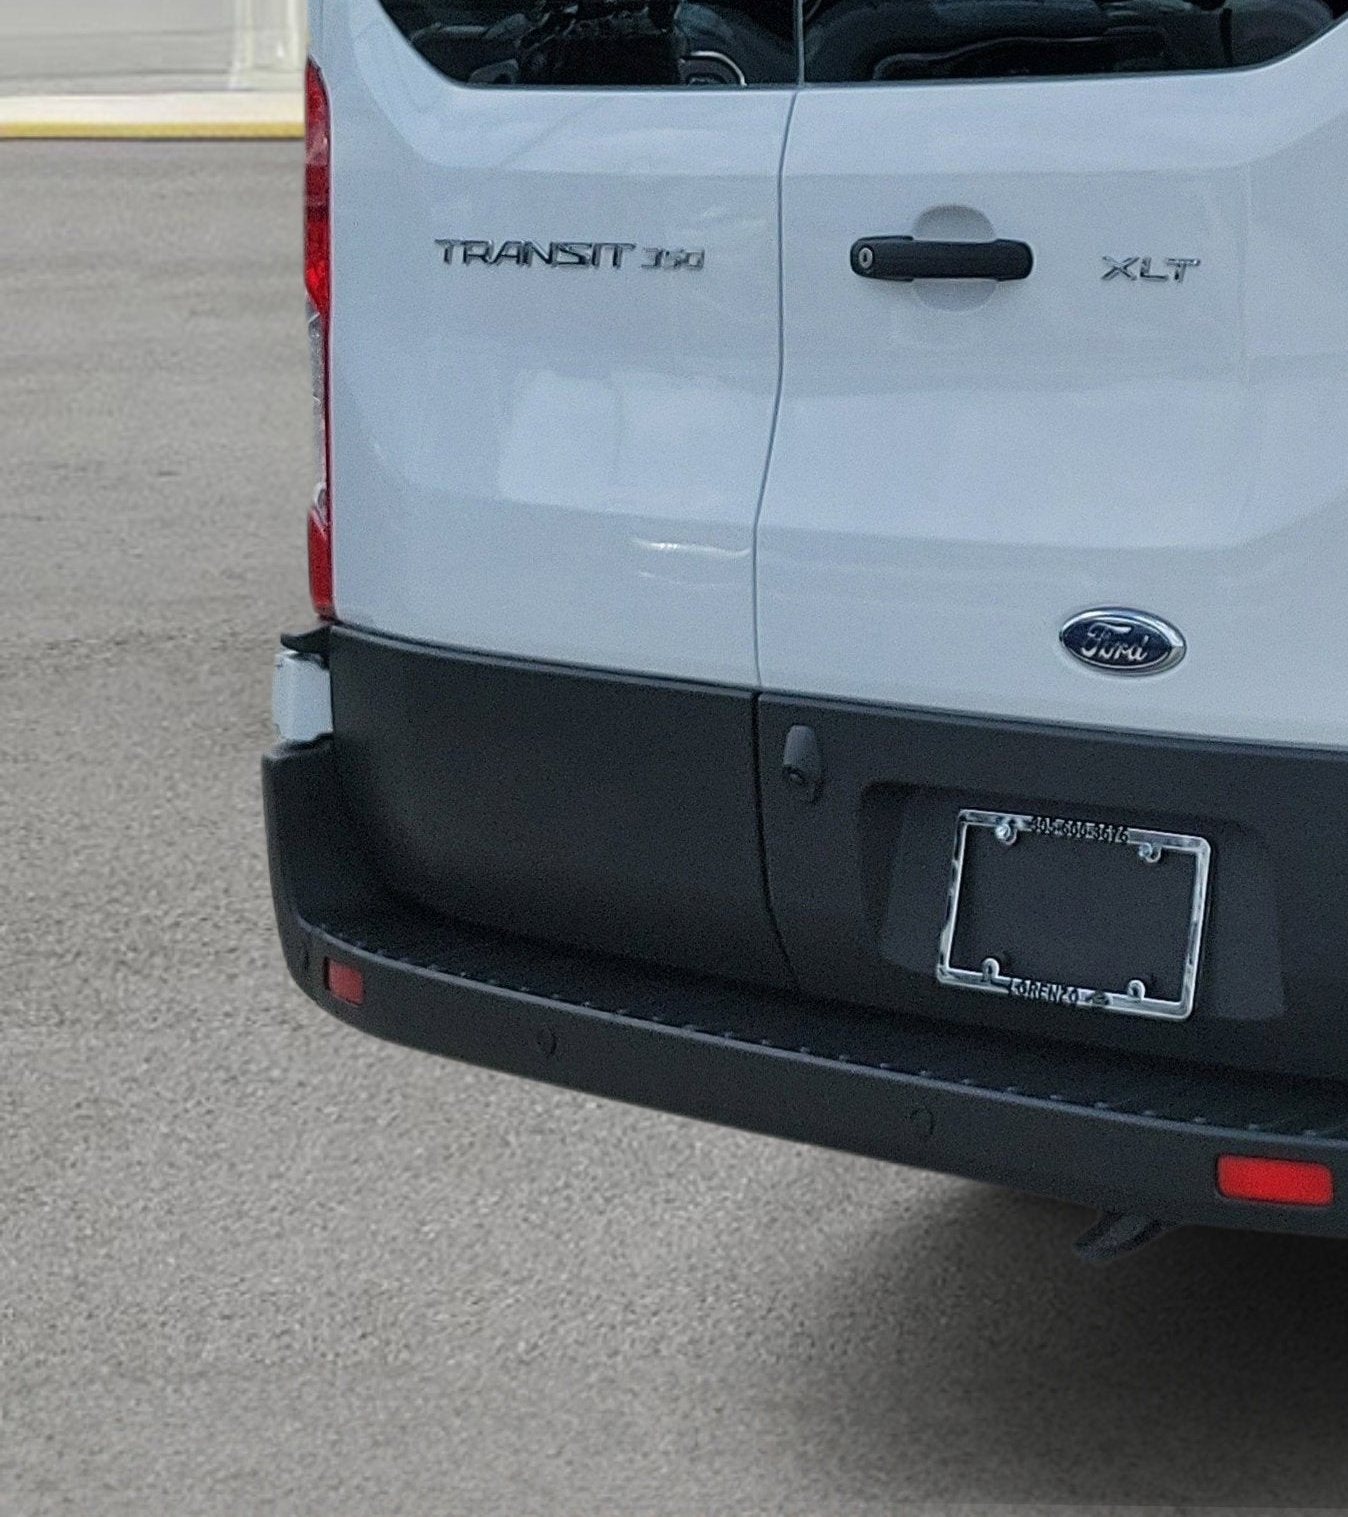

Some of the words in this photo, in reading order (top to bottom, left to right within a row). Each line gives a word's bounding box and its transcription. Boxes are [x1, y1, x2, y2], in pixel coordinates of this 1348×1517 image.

[434, 239, 637, 269] TRANSIT
[641, 247, 705, 271] 350
[1100, 256, 1201, 283] XLT
[1081, 622, 1150, 661] Ford
[1008, 978, 1081, 1005] LORENZO
